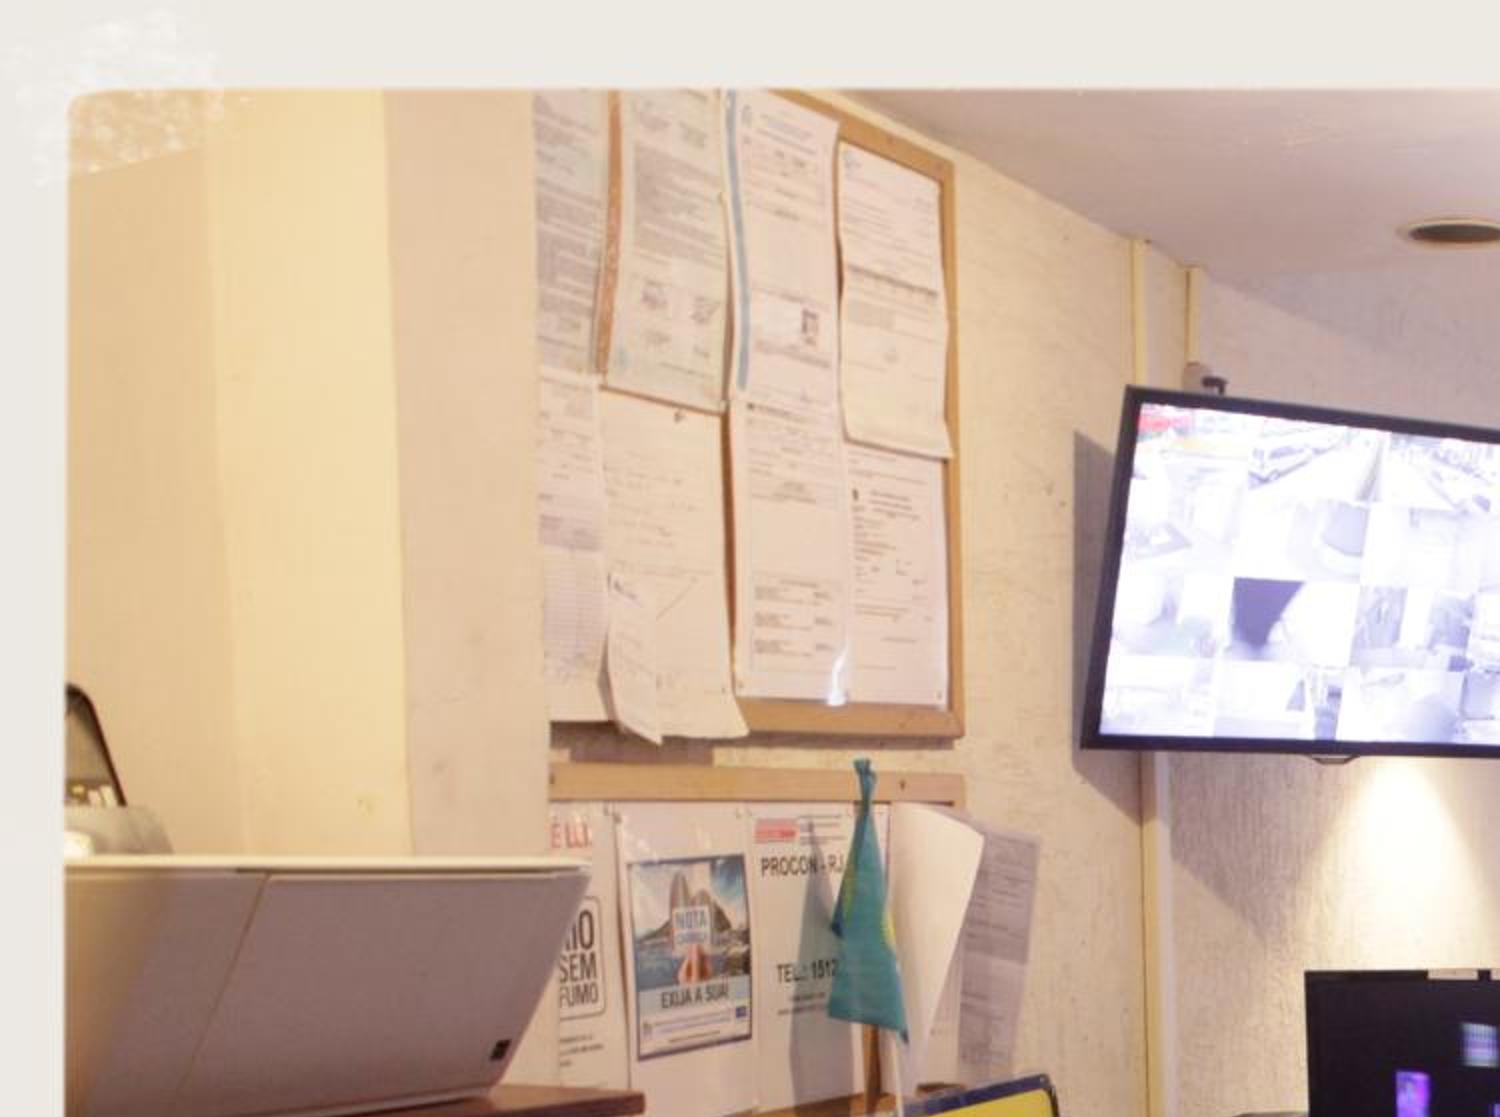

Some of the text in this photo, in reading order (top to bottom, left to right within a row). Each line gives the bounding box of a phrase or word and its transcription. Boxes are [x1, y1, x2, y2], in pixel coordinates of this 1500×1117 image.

[761, 853, 818, 877] PROCON
[827, 853, 844, 874] RJ
[565, 909, 595, 951] IO
[560, 951, 597, 984] SEM
